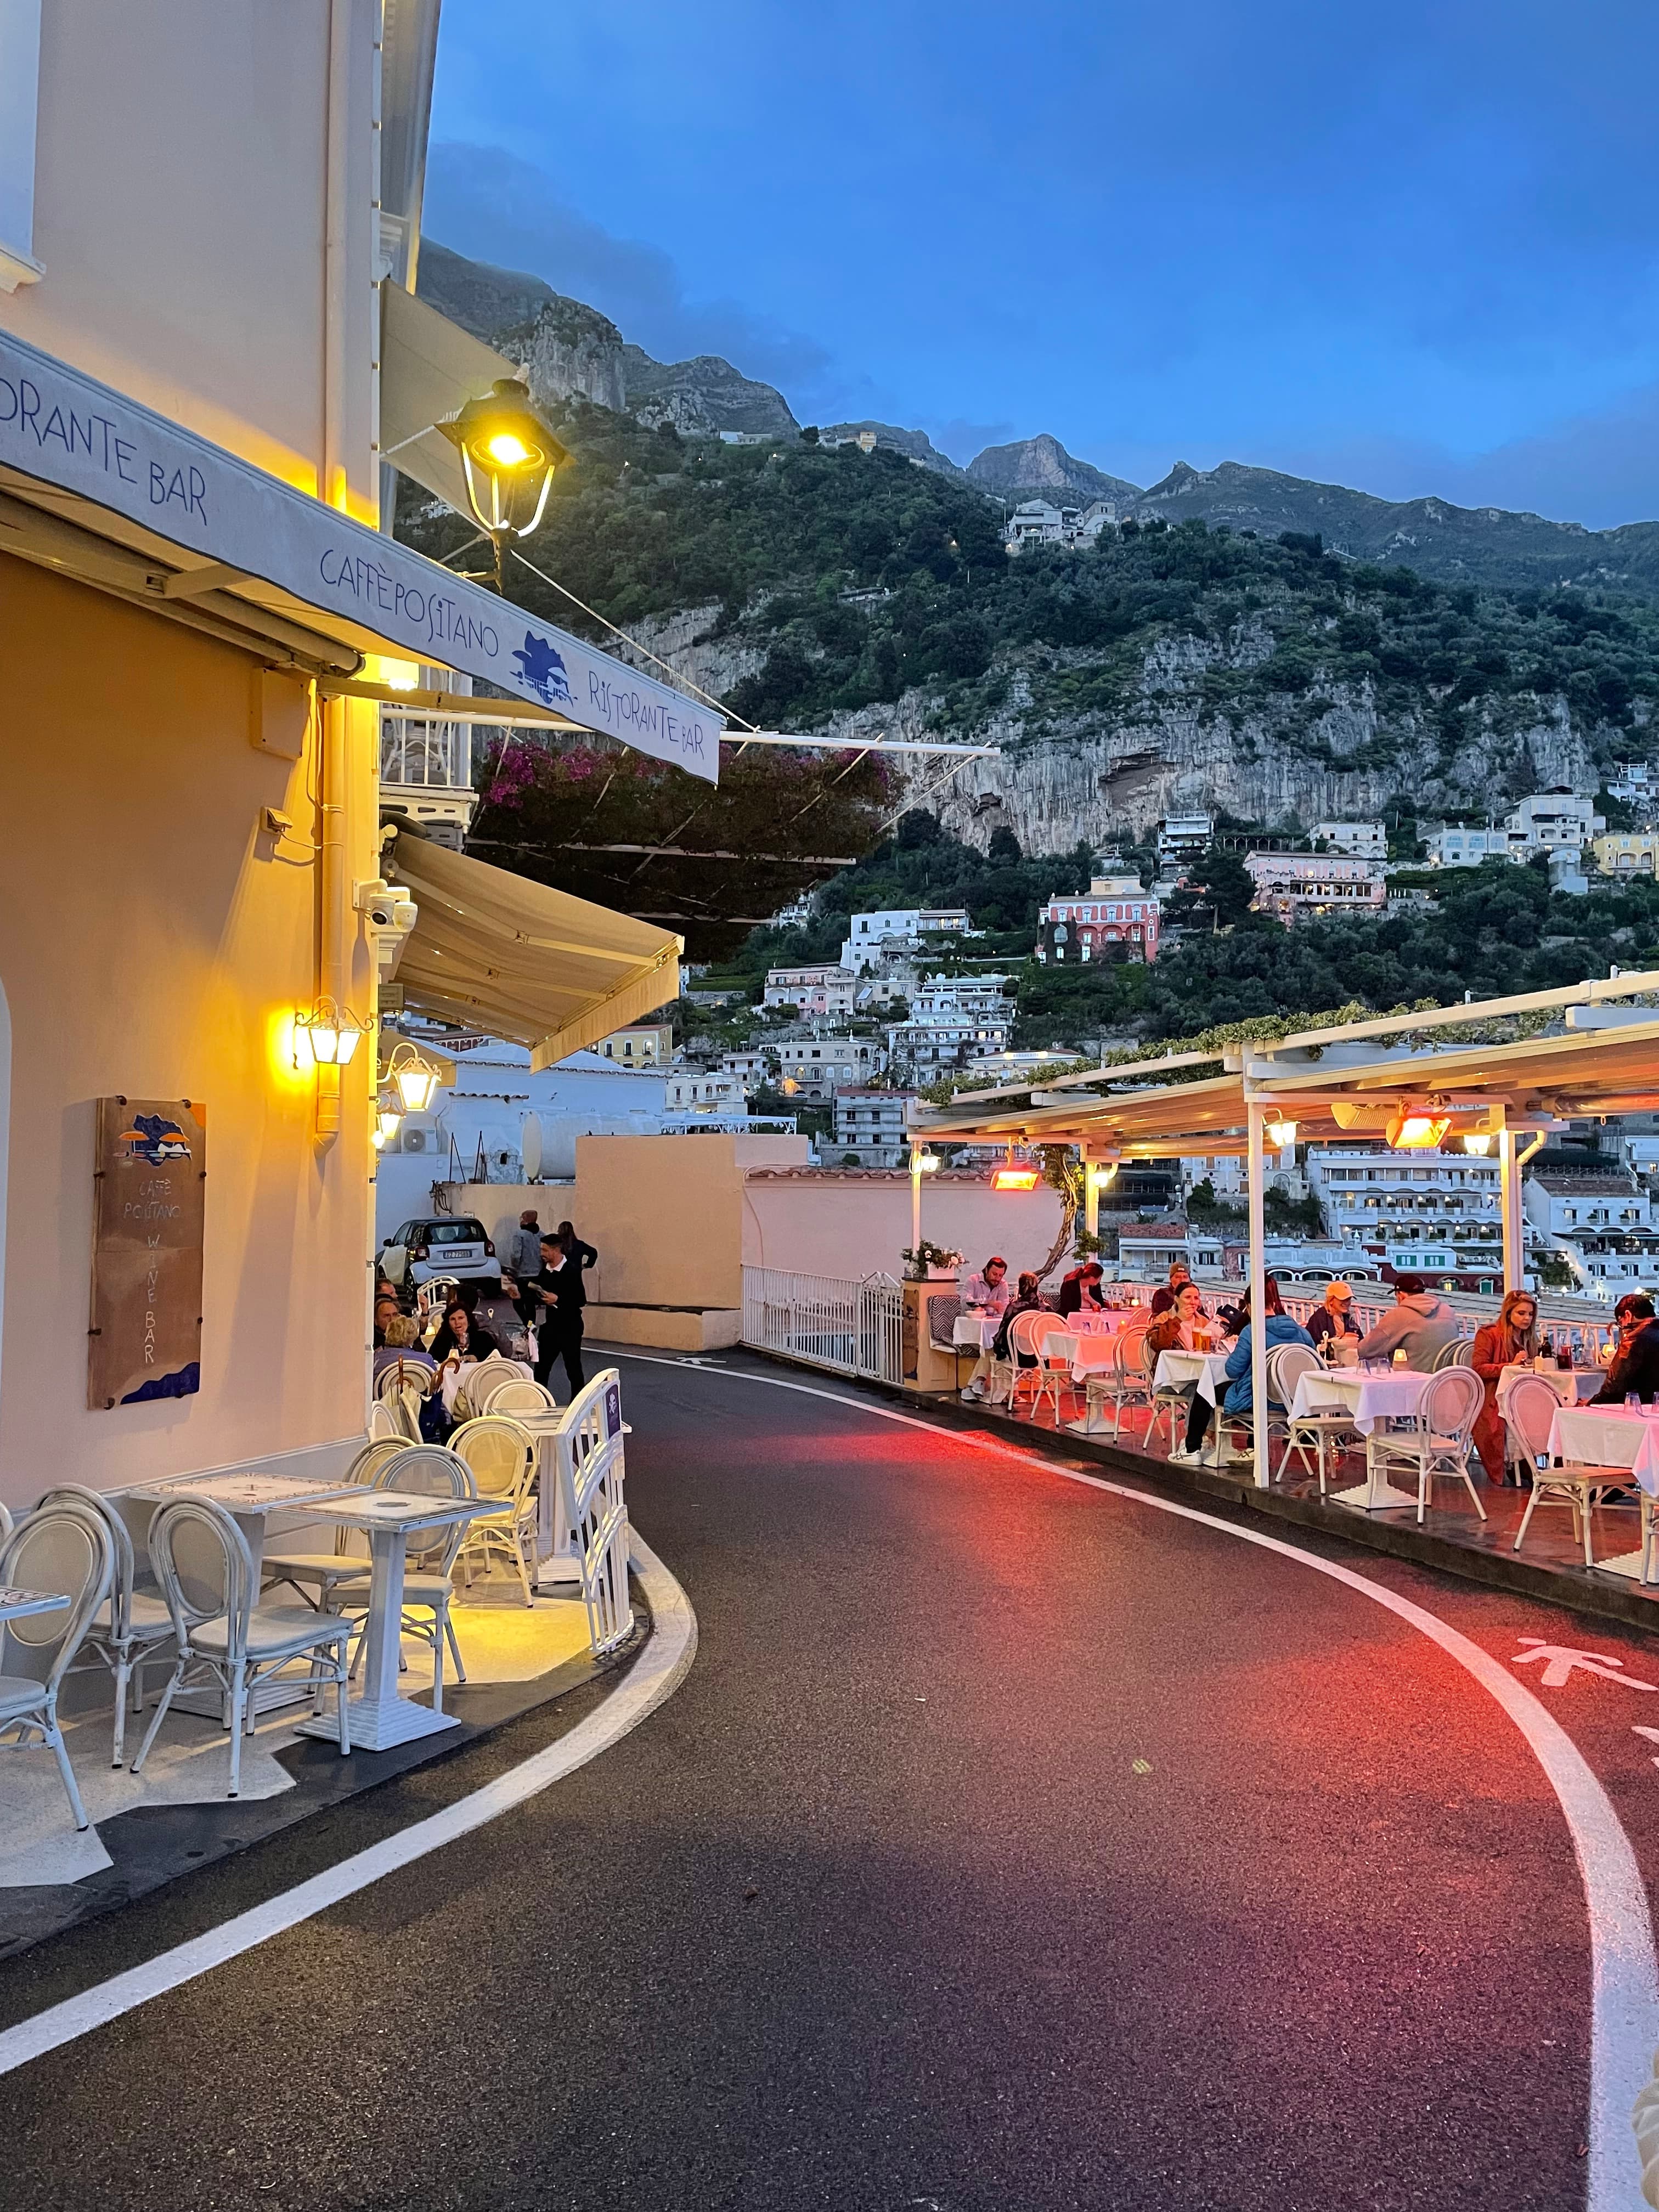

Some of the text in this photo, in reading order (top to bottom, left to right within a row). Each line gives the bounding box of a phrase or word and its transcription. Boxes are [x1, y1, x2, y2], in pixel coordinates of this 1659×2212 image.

[150, 460, 208, 526] BAR
[682, 724, 704, 760] BAR
[144, 1311, 156, 1364] BAR
